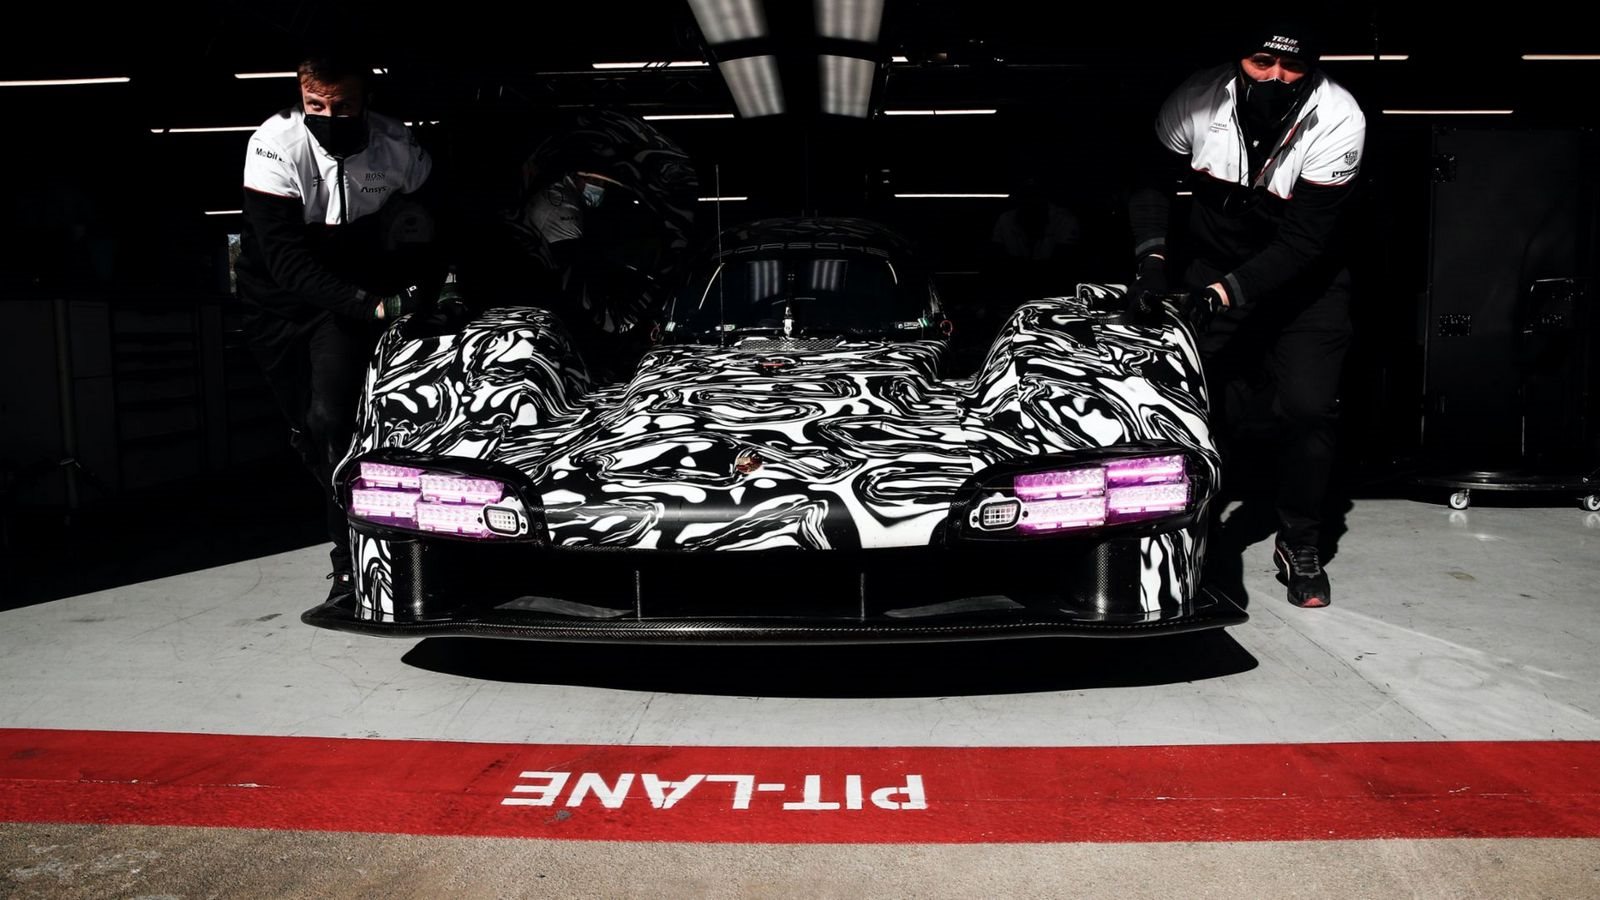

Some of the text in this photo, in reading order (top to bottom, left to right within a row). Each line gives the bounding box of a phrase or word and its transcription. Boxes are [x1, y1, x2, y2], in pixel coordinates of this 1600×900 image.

[1272, 36, 1298, 45] TEAM
[256, 147, 278, 160] Mobil
[361, 186, 388, 194] Ansys
[502, 770, 928, 812] PIT-LANE
